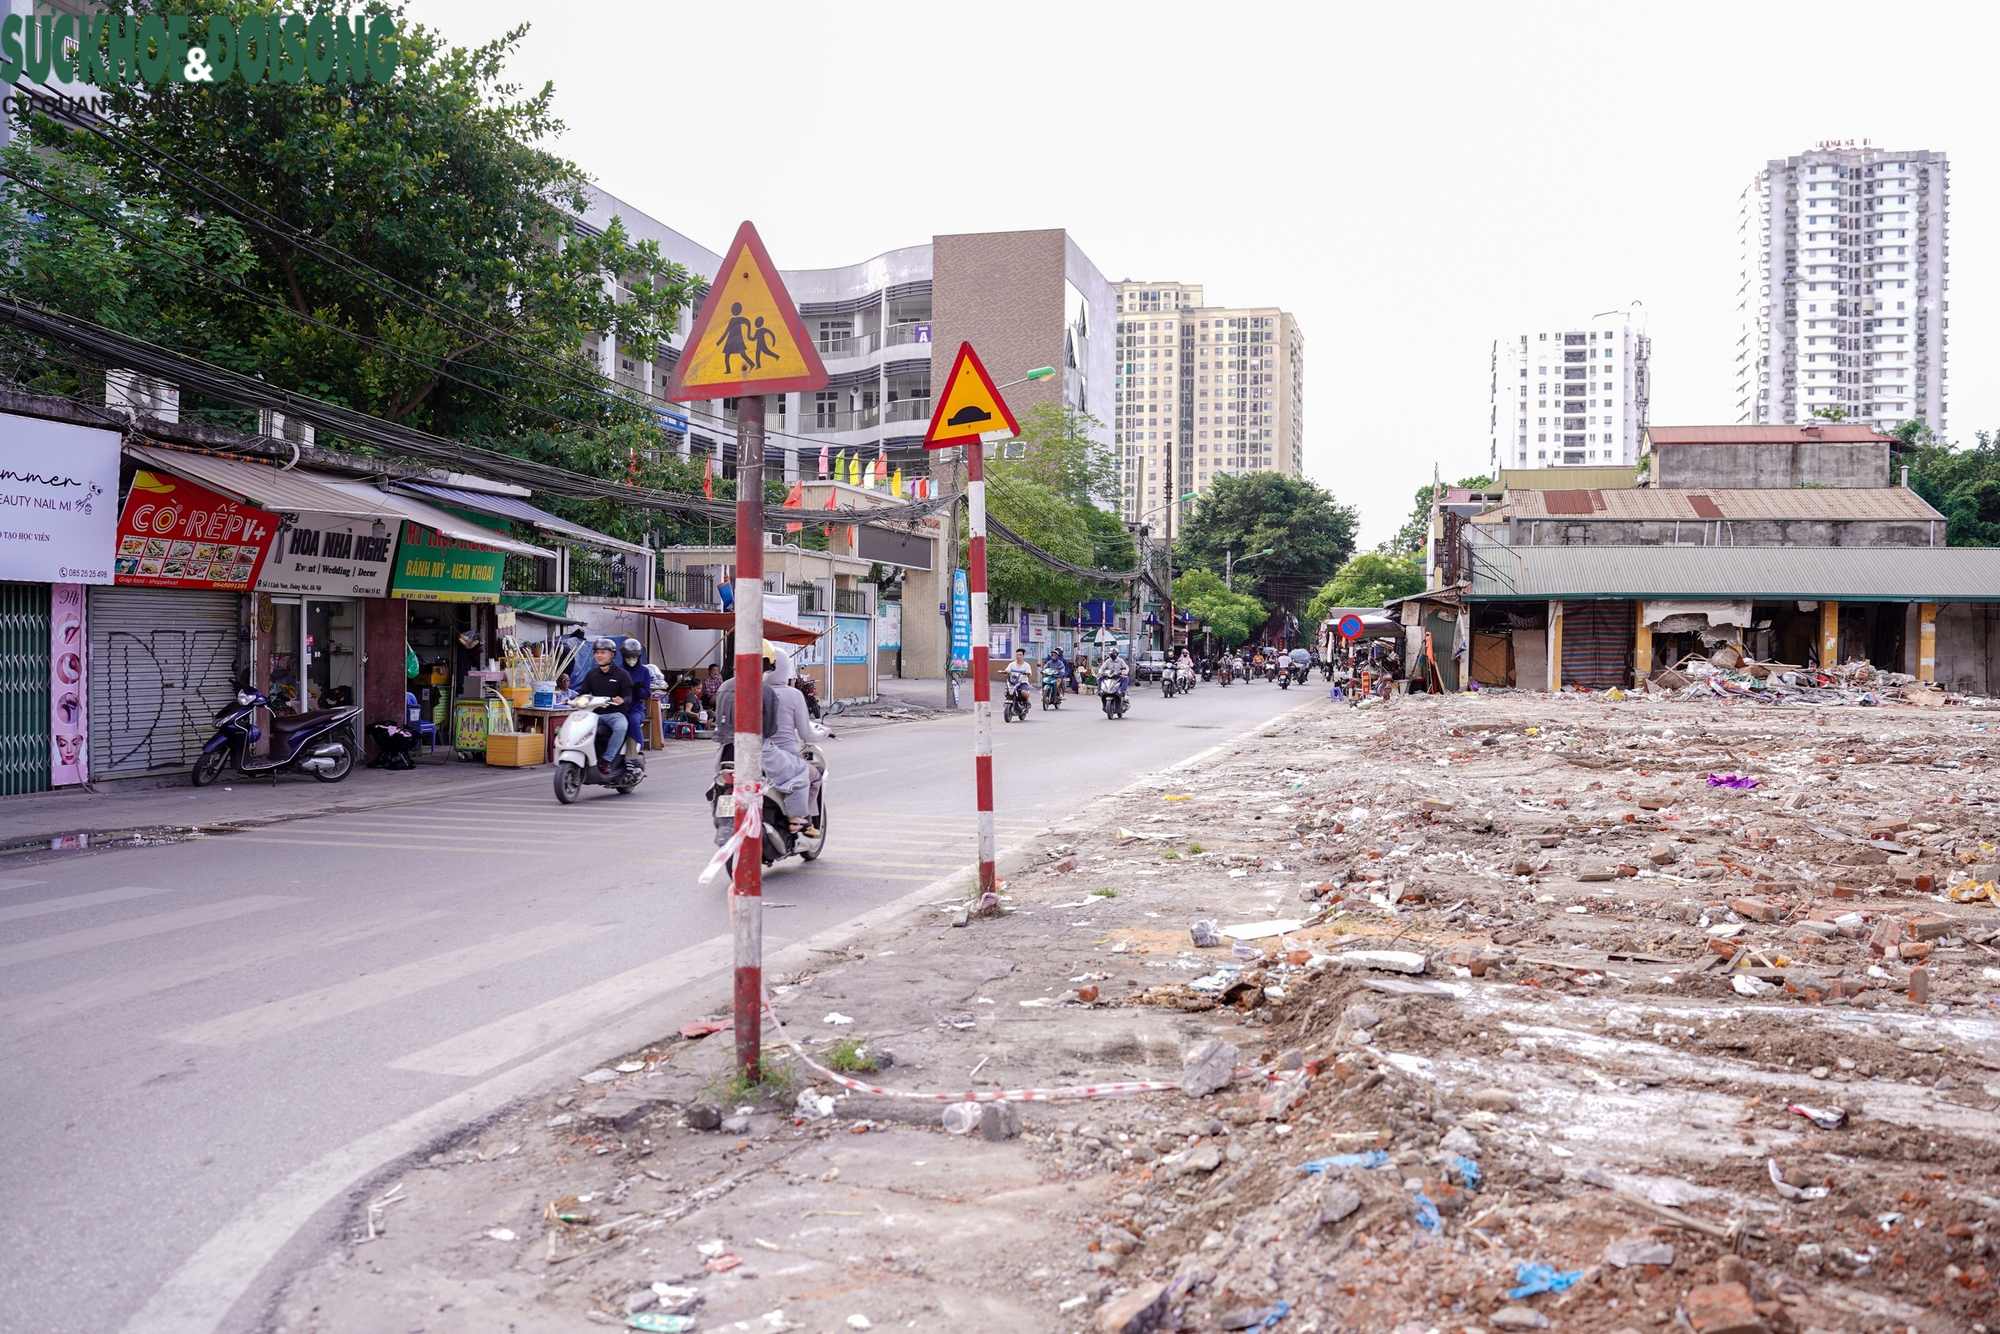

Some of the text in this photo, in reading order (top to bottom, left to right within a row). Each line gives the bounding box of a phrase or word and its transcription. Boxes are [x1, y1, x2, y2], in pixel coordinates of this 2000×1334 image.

[918, 331, 929, 343] A
[33, 497, 57, 511] NAIL
[59, 500, 72, 511] MI
[289, 528, 321, 557] HOA
[321, 527, 353, 560] NHÀ
[353, 532, 392, 562] NGHÉ
[321, 564, 351, 577] Wedding
[357, 567, 378, 578] Decor
[405, 557, 431, 578] BÁNH
[451, 563, 471, 580] NEM
[471, 564, 495, 581] KHOAI
